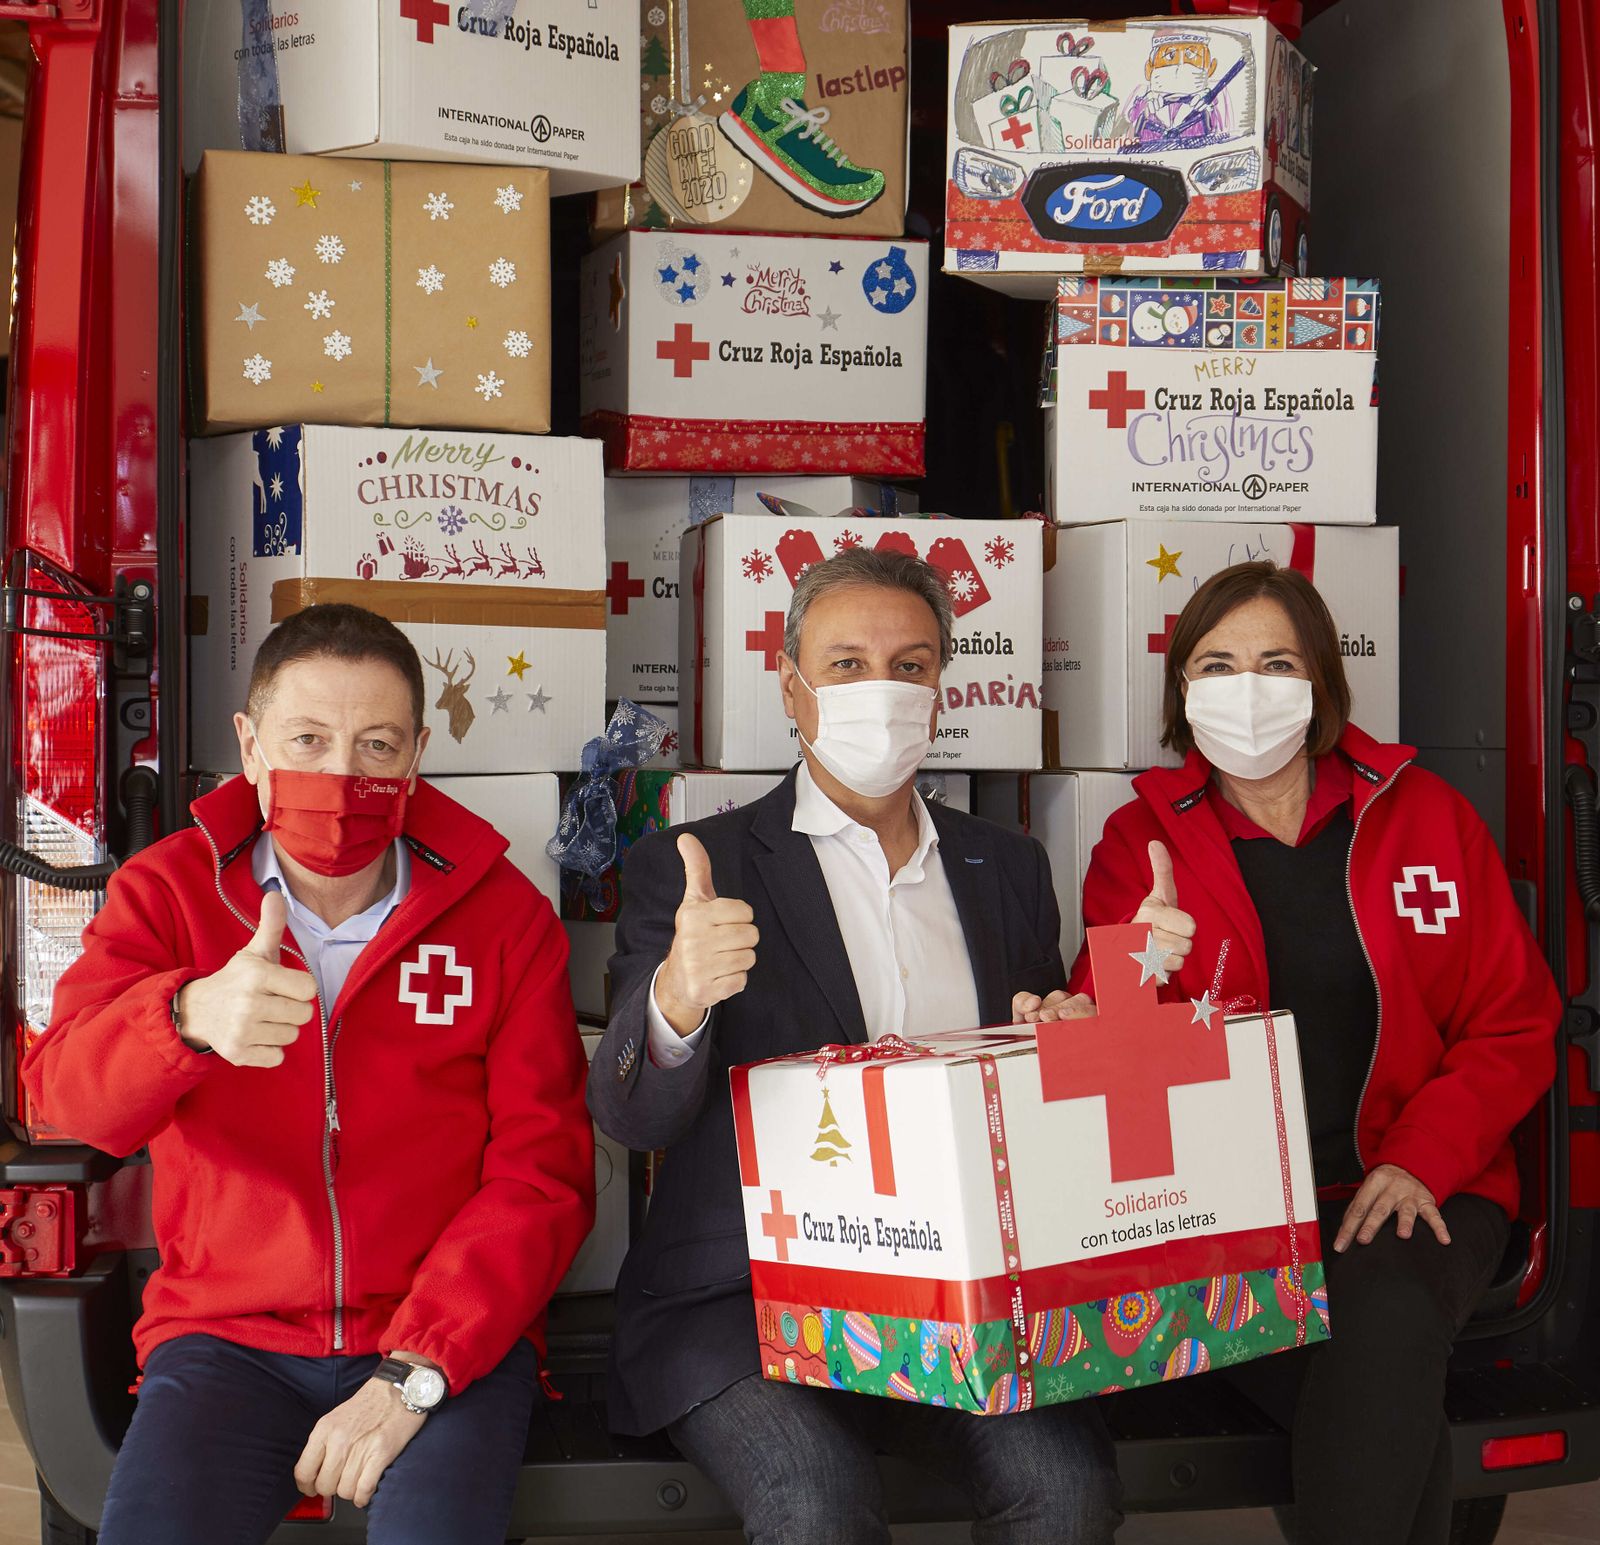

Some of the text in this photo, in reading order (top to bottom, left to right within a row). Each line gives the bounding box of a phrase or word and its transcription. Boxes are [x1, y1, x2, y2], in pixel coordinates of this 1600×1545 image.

[249, 12, 299, 34] Solidarios
[457, 7, 620, 61] Cruz Roja Española
[234, 47, 249, 60] con
[277, 37, 289, 51] las
[291, 33, 316, 48] letras
[816, 64, 905, 98] lastlap
[438, 107, 585, 141] INTERNATIONAL PAPER
[444, 132, 457, 142] Esta
[459, 136, 470, 145] caja
[472, 137, 479, 145] ha
[481, 139, 492, 148] sido
[494, 141, 514, 151] donada
[527, 146, 562, 158] International
[564, 151, 579, 161] Paper
[1065, 134, 1141, 150] Solidarios
[682, 171, 727, 208] 2020
[1053, 174, 1149, 225] Ford
[752, 265, 805, 295] Merry
[741, 289, 811, 317] Christmas
[718, 340, 902, 372] Cruz Roja Española
[1194, 356, 1257, 382] MERRY
[1154, 387, 1354, 417] Cruz Roja Española
[392, 434, 505, 472] Merry
[1127, 402, 1314, 483] Christmas
[358, 473, 542, 517] CHRISTMAS
[1132, 482, 1309, 493] INTERNATIONAL PAPER
[1139, 504, 1302, 513] Esta caja ha sido donada por International Paper
[652, 576, 680, 599] Cru
[240, 562, 248, 645] Solidarios
[950, 631, 1014, 661] pañola
[1340, 633, 1376, 657] ñola
[1054, 659, 1062, 671] las
[1064, 657, 1081, 671] letras
[936, 728, 969, 739] APER
[943, 751, 962, 760] Paper
[987, 1104, 996, 1134] MERRY
[1104, 1188, 1188, 1219] Solidarios
[803, 1211, 943, 1257] Cruz Roja Española
[1081, 1211, 1217, 1250] con todas las letras
[1011, 1296, 1019, 1327] MERRY
[1015, 1286, 1025, 1336] CHRISTMAS
